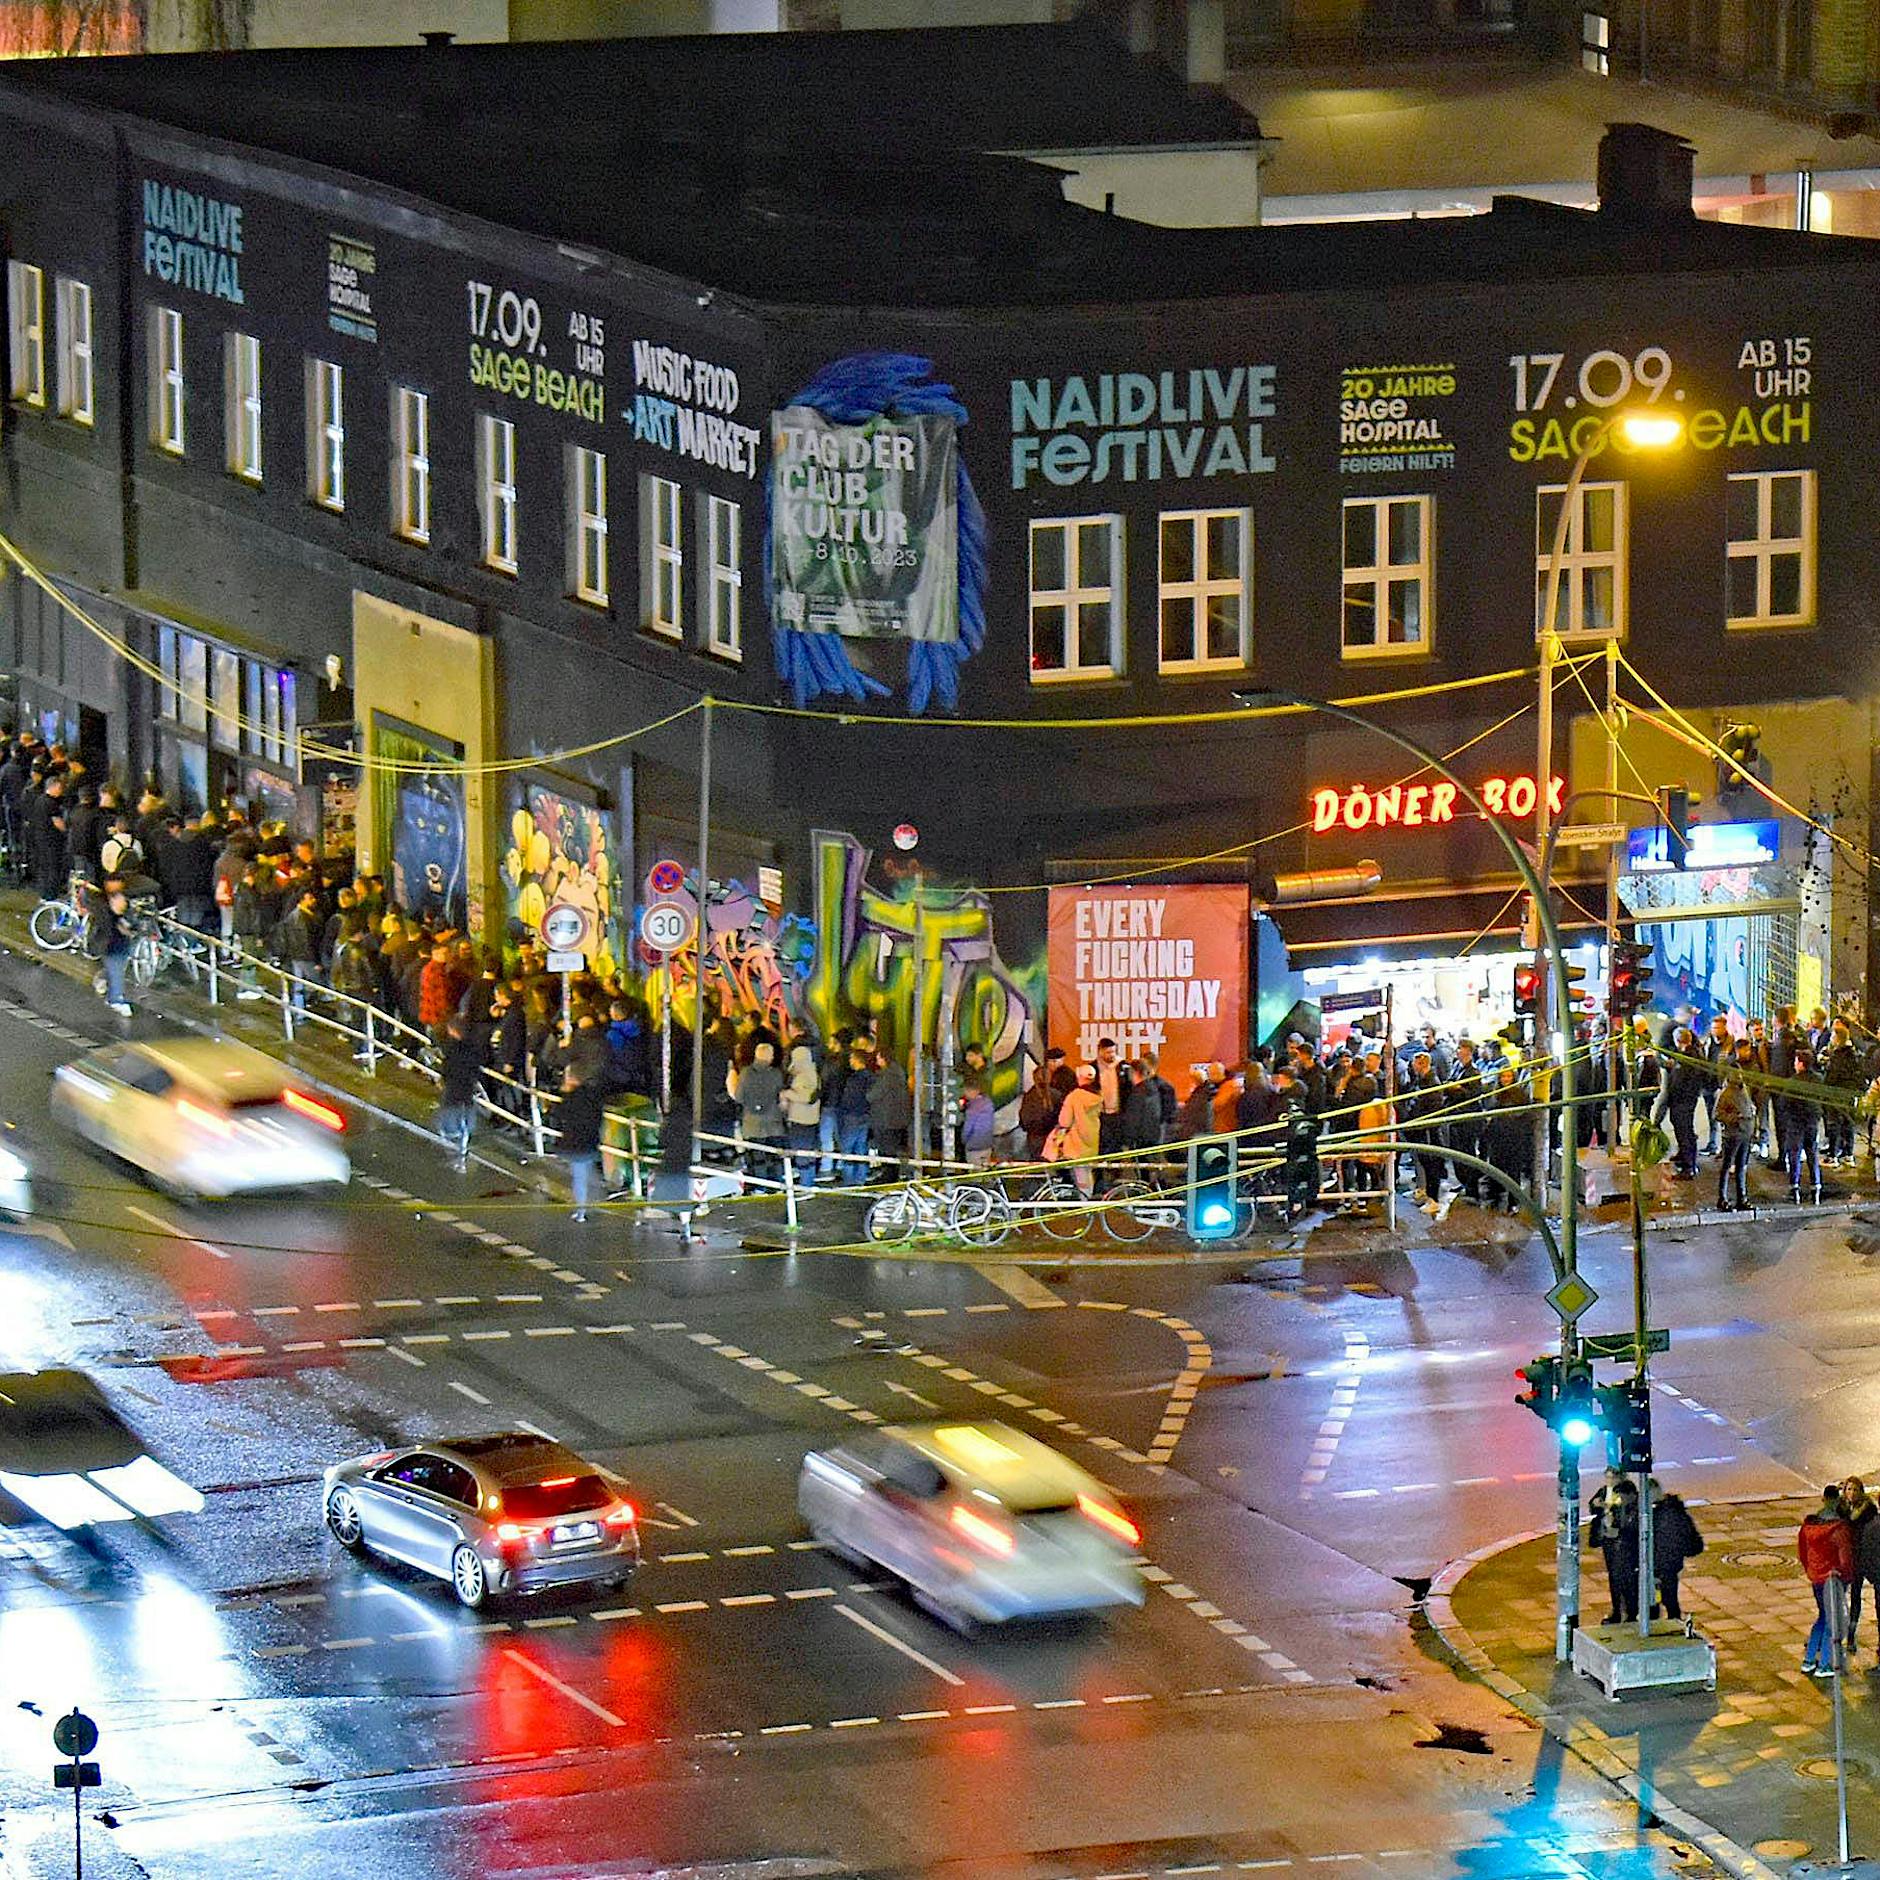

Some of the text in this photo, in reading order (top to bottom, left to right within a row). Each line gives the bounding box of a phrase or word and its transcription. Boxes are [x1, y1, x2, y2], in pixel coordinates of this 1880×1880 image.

[143, 179, 243, 254] NAIDLIVE
[467, 280, 547, 357] 17.09.
[569, 311, 604, 346] AB 15
[576, 342, 604, 376] UHR
[1738, 337, 1811, 369] AB 15
[632, 339, 740, 414] MUSIC FOOD
[1341, 378, 1374, 399] 20
[1508, 347, 1686, 411] 17.09.
[1755, 368, 1811, 398] UHR
[1010, 365, 1277, 432] NAIDLIVE
[676, 405, 761, 480] MARKET
[783, 427, 915, 472] TAG DER
[1660, 402, 1811, 454] eACH
[783, 465, 868, 506] CLUB
[783, 500, 909, 545] KULTUR
[1313, 775, 1565, 832] DÖNER BOX
[653, 915, 681, 936] 30
[1076, 899, 1166, 938] EVERY
[1076, 939, 1194, 979] FUCKING
[1076, 979, 1221, 1020] THURSDAY
